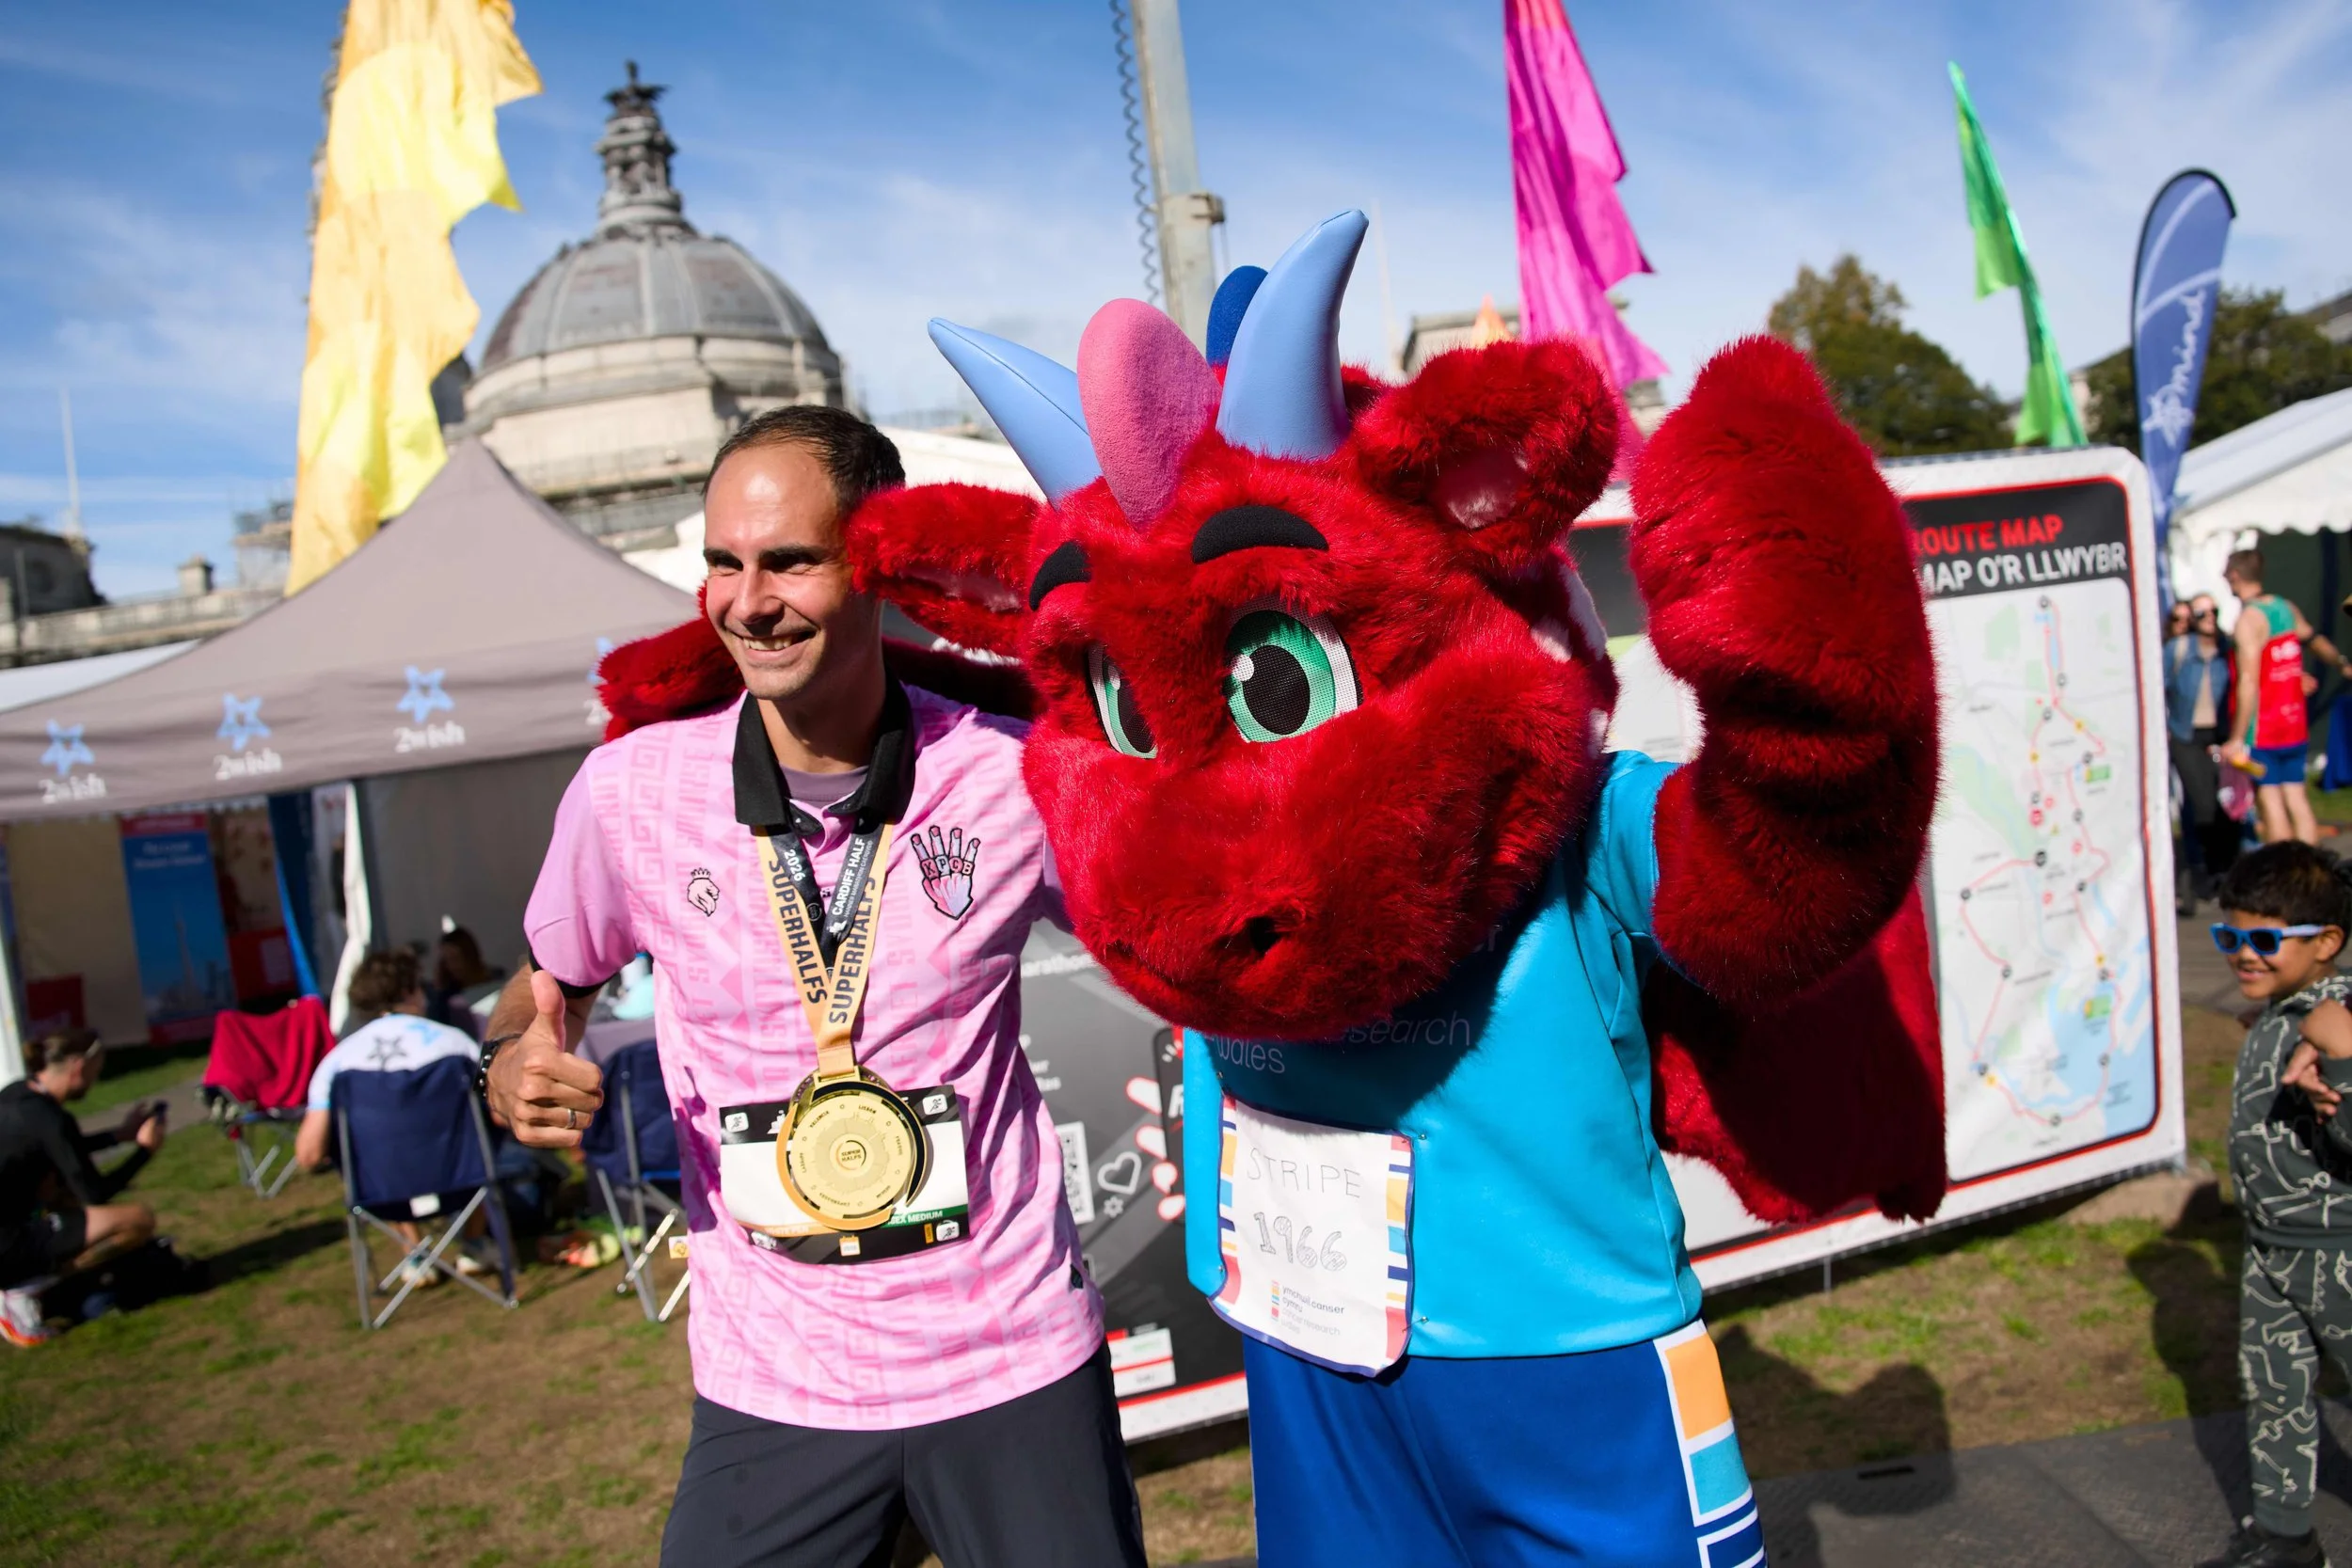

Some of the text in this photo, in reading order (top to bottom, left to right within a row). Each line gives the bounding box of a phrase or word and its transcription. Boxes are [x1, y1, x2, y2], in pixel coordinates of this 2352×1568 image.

[2000, 514, 2064, 548] MAP
[1977, 553, 2025, 588] O'R
[2026, 541, 2128, 582] LLWYBR
[393, 721, 466, 752] 2wish
[213, 748, 282, 781] 2wish
[784, 848, 805, 881] 2026
[832, 837, 866, 916] CARDIFF HALF
[768, 860, 828, 1005] SUPERHALFS
[1247, 1148, 1361, 1199] STRIPE
[907, 1210, 943, 1223] MEDIUM
[1253, 1212, 1347, 1272] 1966
[1311, 1300, 1344, 1315] canser
